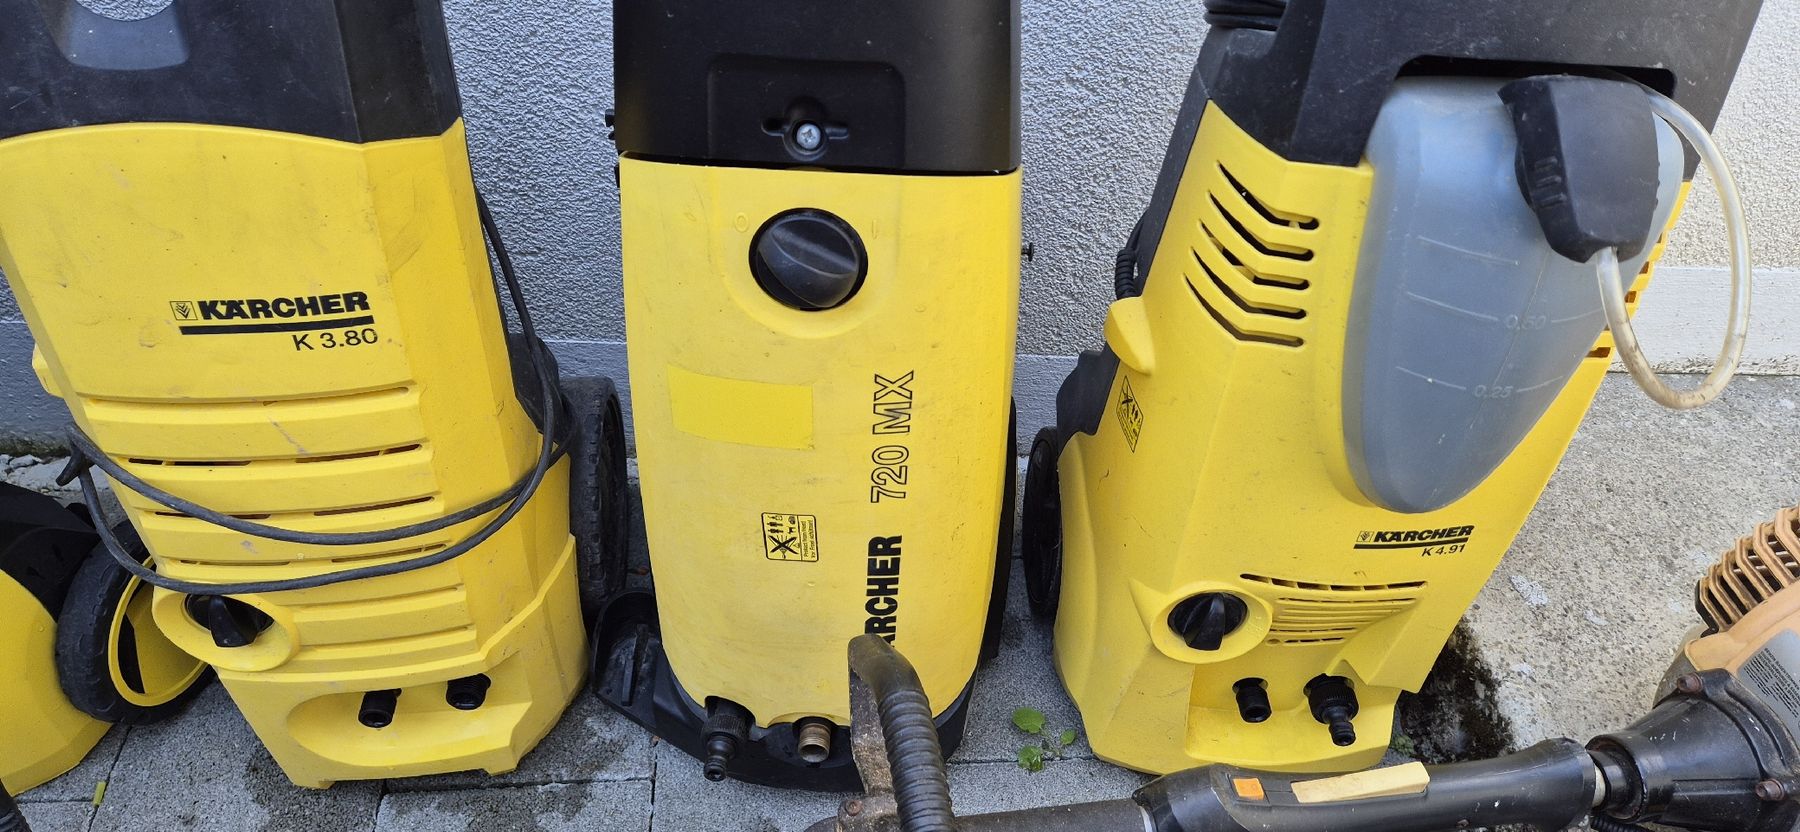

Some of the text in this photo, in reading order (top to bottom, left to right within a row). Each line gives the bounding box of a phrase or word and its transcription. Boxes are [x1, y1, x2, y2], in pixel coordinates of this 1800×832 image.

[197, 291, 371, 320] KÄRCHER
[292, 328, 378, 351] K 3.80
[1474, 384, 1514, 399] 0.25
[864, 370, 914, 648] RCHER 720 MX
[1373, 525, 1475, 543] KÄRCHER
[1421, 544, 1466, 557] K 4.91
